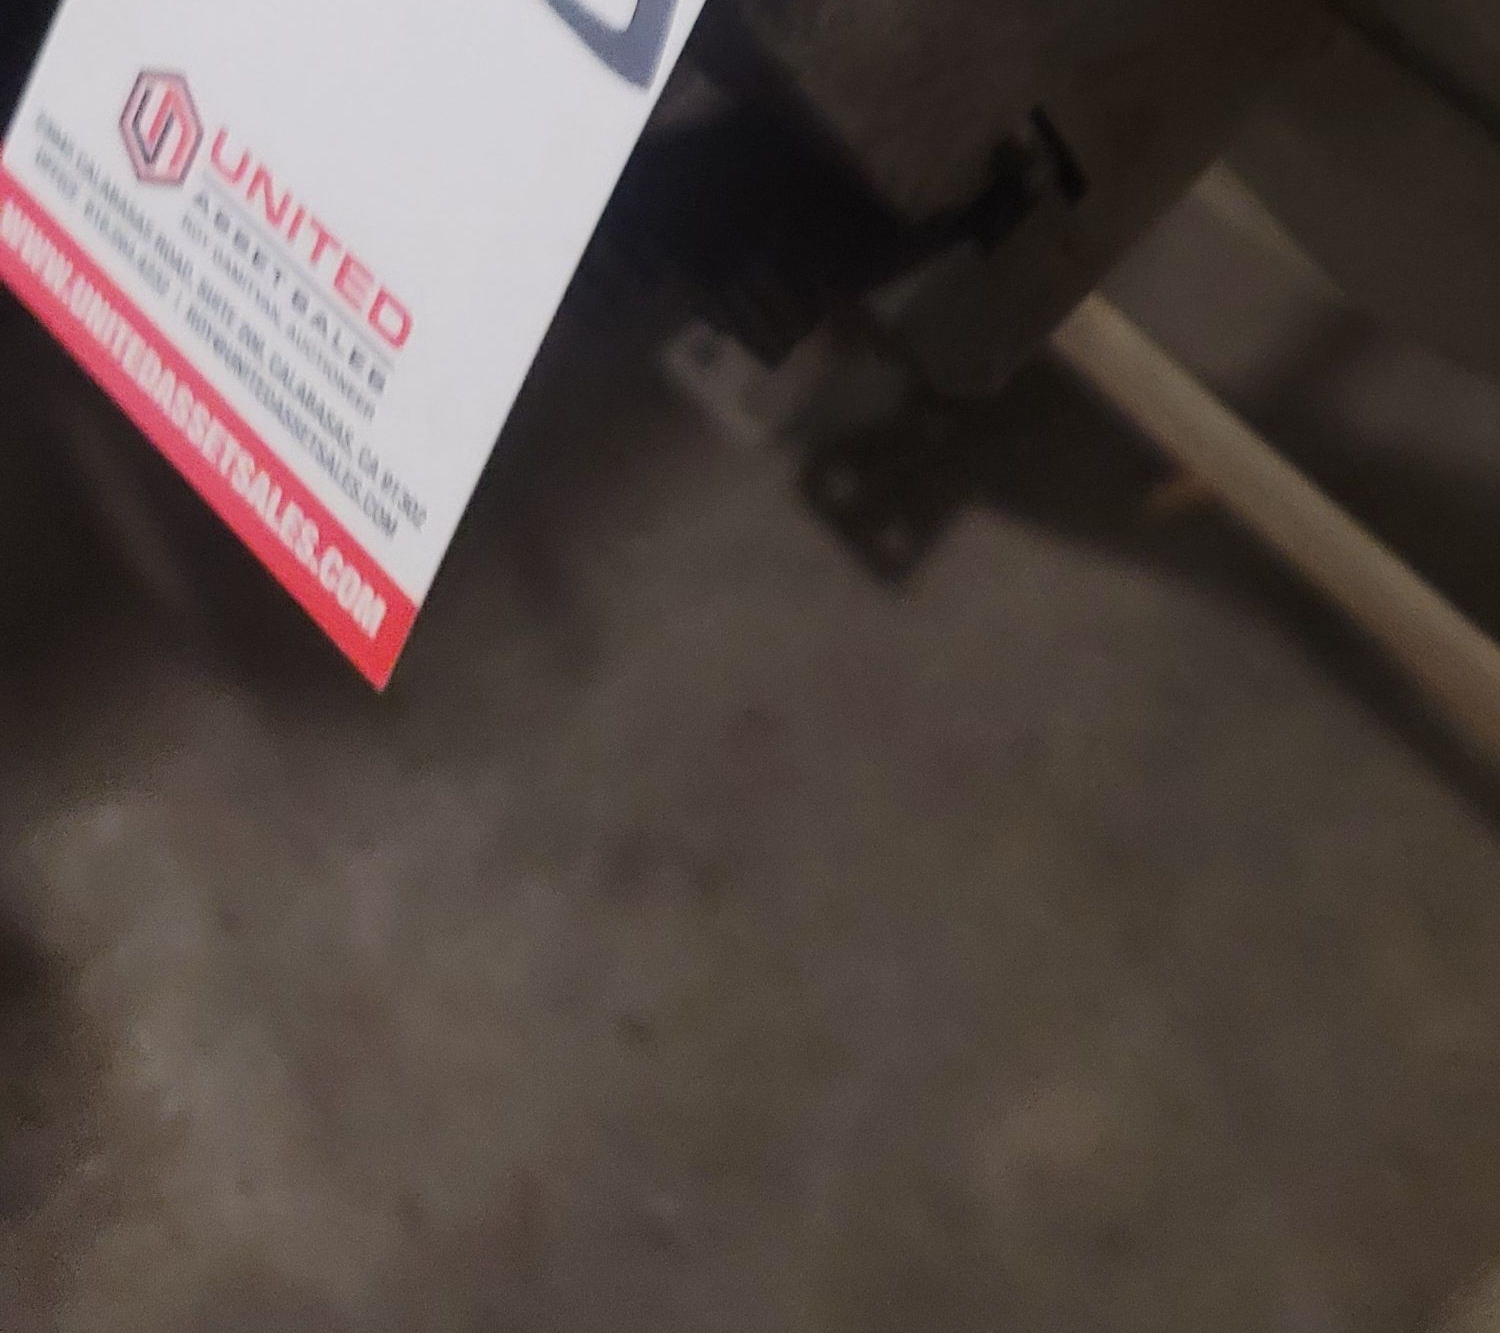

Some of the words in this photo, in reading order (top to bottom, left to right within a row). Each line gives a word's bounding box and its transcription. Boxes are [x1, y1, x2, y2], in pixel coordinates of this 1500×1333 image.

[192, 191, 285, 295] ASSET
[290, 285, 387, 394] SALES
[210, 127, 414, 351] UNITED
[2, 197, 388, 641] WWW.UNITEDASSETSALES.COM
